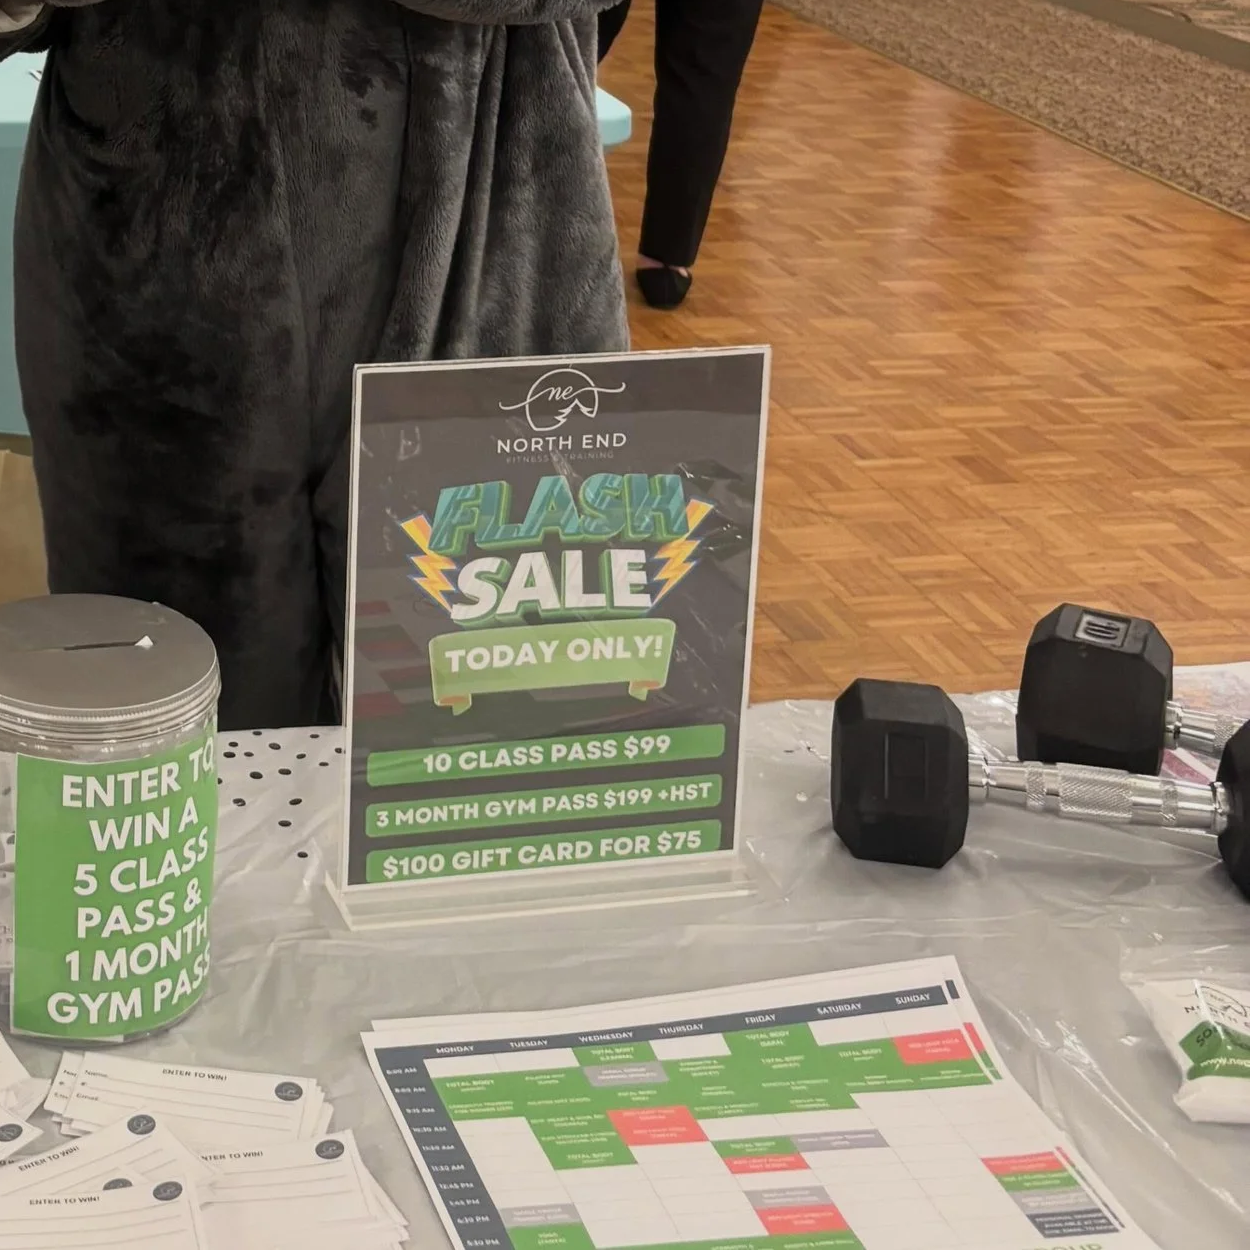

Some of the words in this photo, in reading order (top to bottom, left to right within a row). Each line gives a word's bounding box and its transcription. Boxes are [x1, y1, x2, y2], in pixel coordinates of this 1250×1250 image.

[497, 435, 572, 454] NORTH
[582, 433, 627, 448] END
[506, 453, 550, 464] FITNESS
[564, 451, 614, 461] TRAINING
[429, 473, 690, 553] FLASH
[450, 549, 652, 623] SALE
[445, 640, 560, 673] TODAY
[566, 635, 663, 661] ONLY!
[61, 758, 180, 808] ENTER
[188, 739, 215, 784] TO
[424, 752, 452, 774] 10
[458, 745, 544, 770] CLASS
[551, 740, 618, 763] PASS
[623, 734, 672, 759] $99
[88, 806, 171, 851] WIN
[178, 796, 200, 833] A
[376, 811, 390, 828] 3
[395, 803, 480, 827] MONTH
[484, 798, 537, 818] GYM
[542, 792, 599, 813] PASS
[603, 787, 654, 810] $199
[657, 781, 714, 803] +HST
[73, 863, 98, 896] 5
[109, 826, 209, 894] CLASS
[382, 853, 447, 881] $100
[452, 847, 513, 871] GIFT
[517, 840, 594, 865] CARD
[600, 835, 651, 857] FOR
[657, 829, 702, 855] $75
[77, 895, 174, 939] PASS
[183, 877, 202, 911] &
[64, 949, 81, 981] 1
[92, 906, 209, 982] MONTH
[47, 987, 143, 1025] GYM
[152, 946, 211, 1013] PASS
[436, 1045, 475, 1054] MONDAY
[509, 1039, 548, 1049] TUESDAY
[578, 1031, 634, 1043] WEDNESDAY
[658, 1023, 704, 1035] THURSDAY
[744, 1014, 777, 1025] FRIDAY
[816, 1002, 863, 1015] SATURDAY
[895, 993, 931, 1005] SUNDAY
[162, 1068, 192, 1078] ENTER
[194, 1070, 206, 1079] TO
[207, 1073, 228, 1081] WIN!
[18, 1158, 47, 1172] ENTER
[47, 1153, 61, 1162] TO
[201, 1153, 227, 1162] NTER
[228, 1152, 241, 1160] TO
[242, 1150, 264, 1159] WIN!
[29, 1198, 62, 1206] ENTER
[64, 1196, 77, 1205] TO
